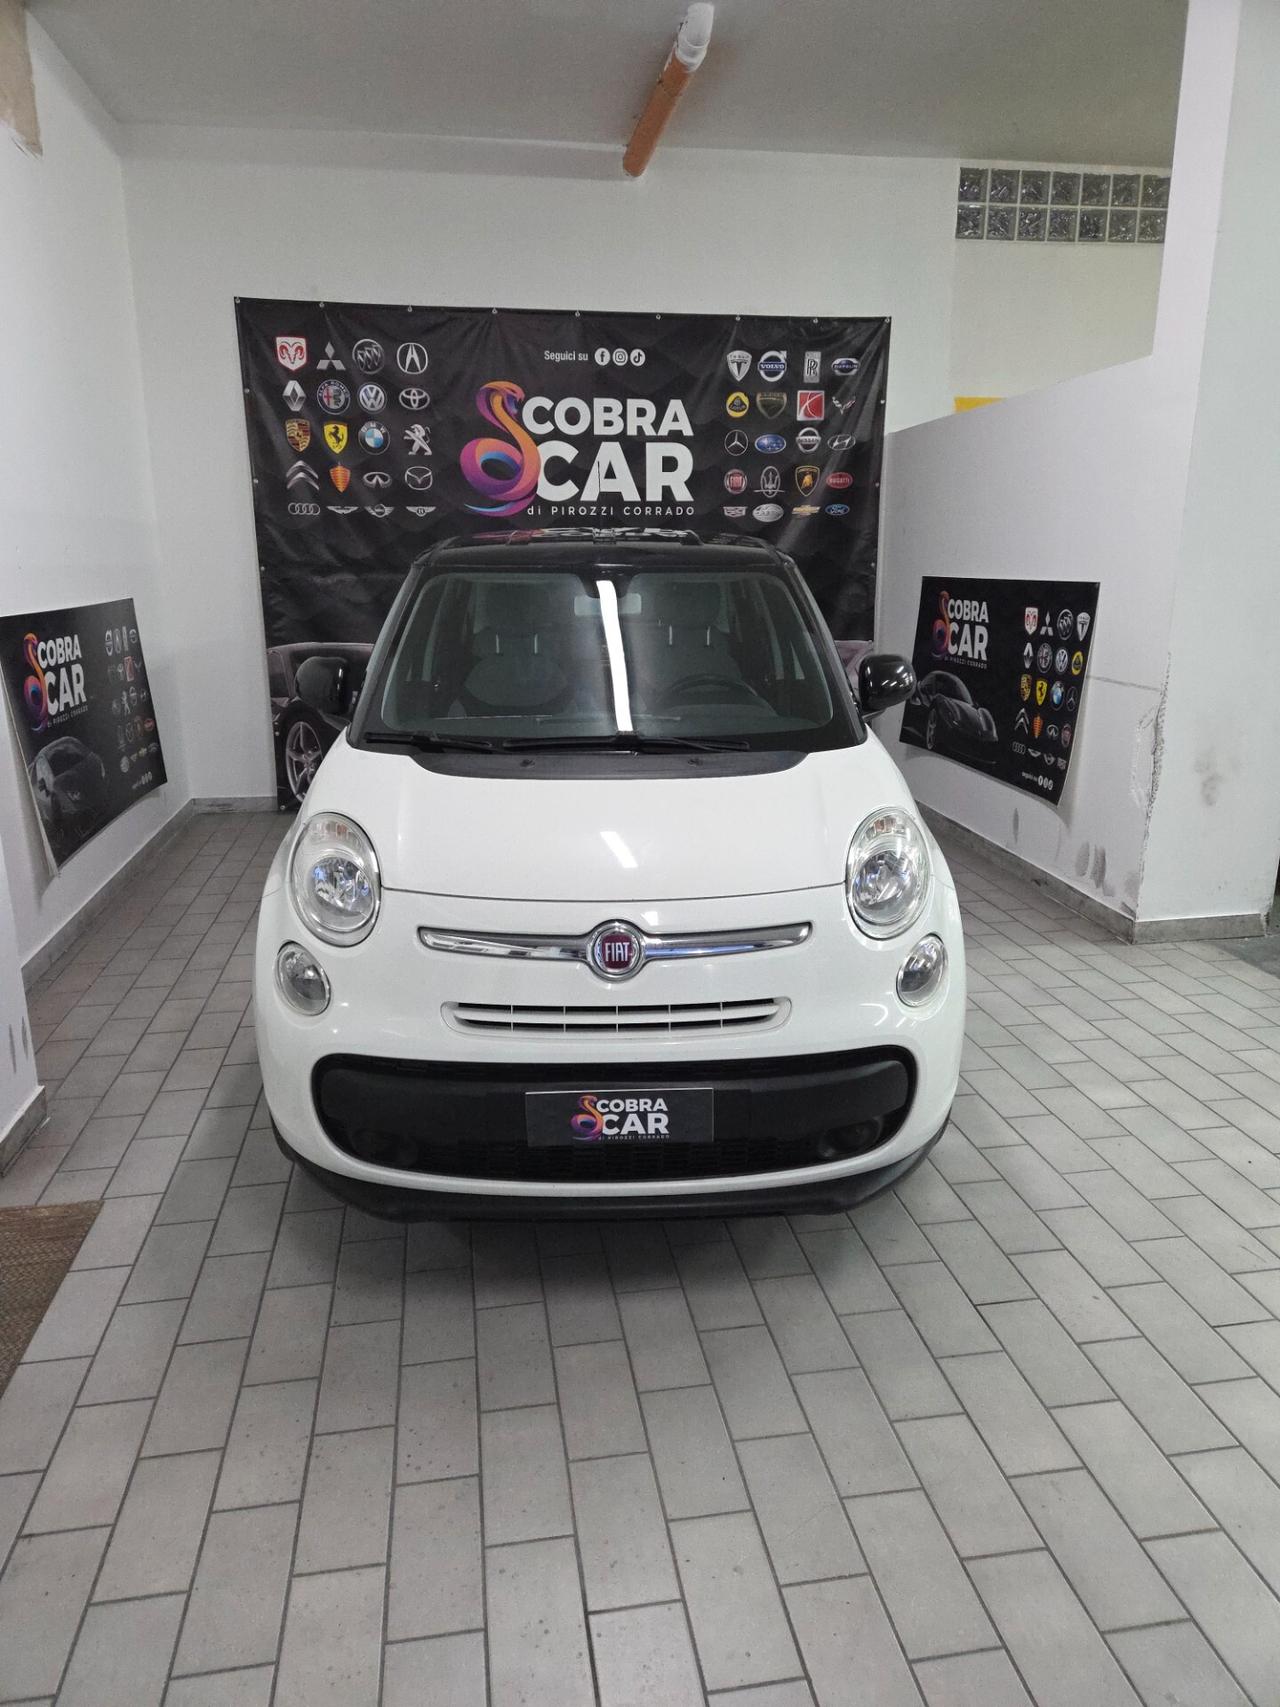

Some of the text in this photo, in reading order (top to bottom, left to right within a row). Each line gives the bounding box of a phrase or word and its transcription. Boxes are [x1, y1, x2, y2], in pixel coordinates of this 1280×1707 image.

[544, 350, 589, 363] Seguici su
[521, 396, 694, 437] COBRA
[535, 439, 694, 502] CAR
[527, 506, 695, 516] di PIROZZI CORRADO
[947, 598, 989, 624] COBRA
[37, 634, 82, 668] COBRA
[947, 621, 988, 662] CAR
[45, 663, 87, 717] CAR
[604, 941, 630, 962] FIAT
[596, 1097, 669, 1113] COBRA
[602, 1112, 670, 1136] CAR
